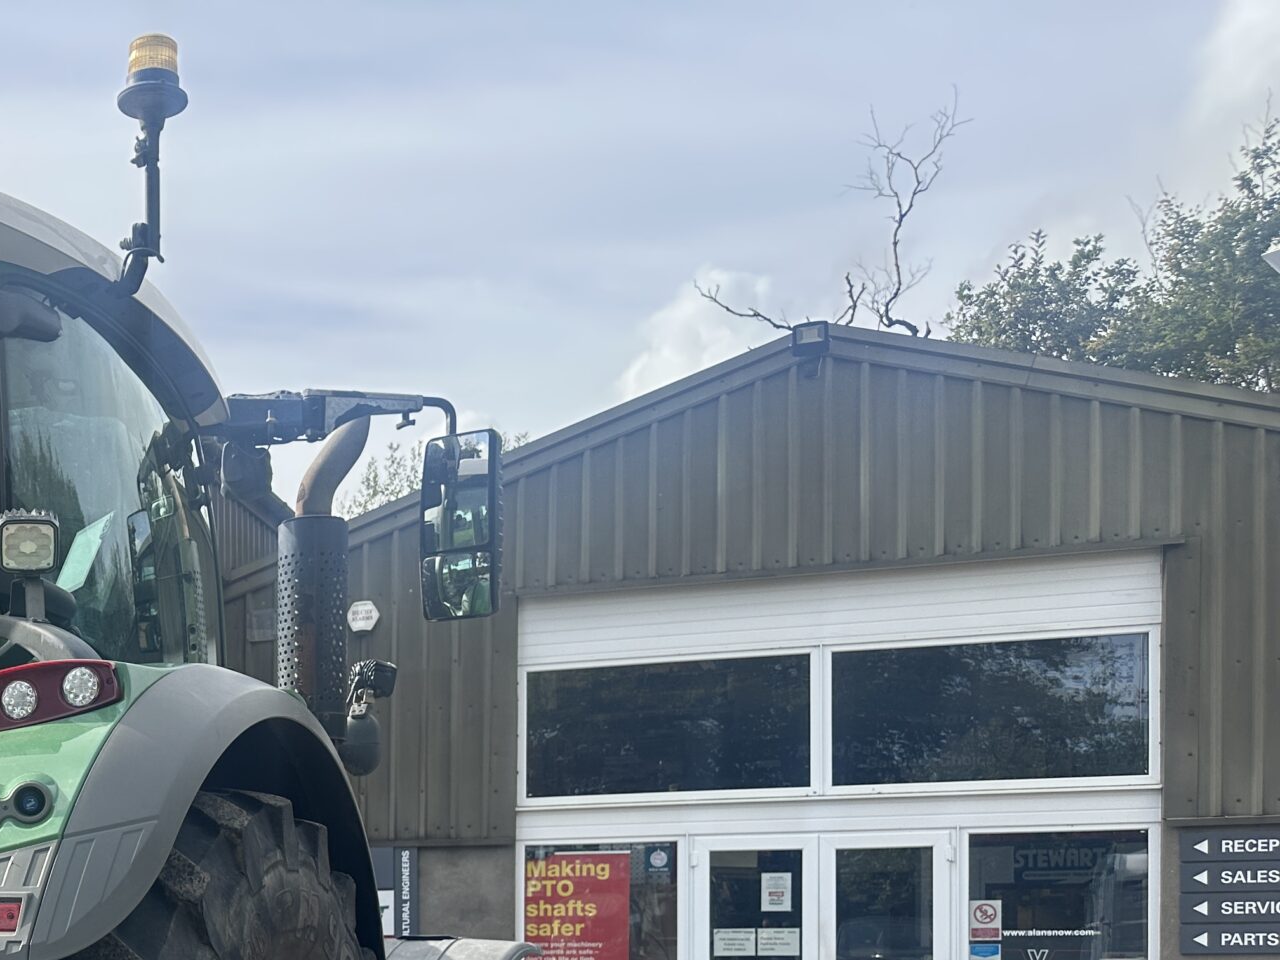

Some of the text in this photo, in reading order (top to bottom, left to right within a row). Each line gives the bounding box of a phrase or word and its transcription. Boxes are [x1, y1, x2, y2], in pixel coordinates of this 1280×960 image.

[1221, 839, 1280, 853] RECEP
[401, 850, 410, 900] ENGINEERS
[527, 860, 610, 880] Making
[1220, 870, 1280, 883] SALES
[527, 880, 574, 897] PTO
[526, 900, 597, 917] shafts
[526, 920, 585, 937] safer
[1221, 933, 1279, 946] PARTS
